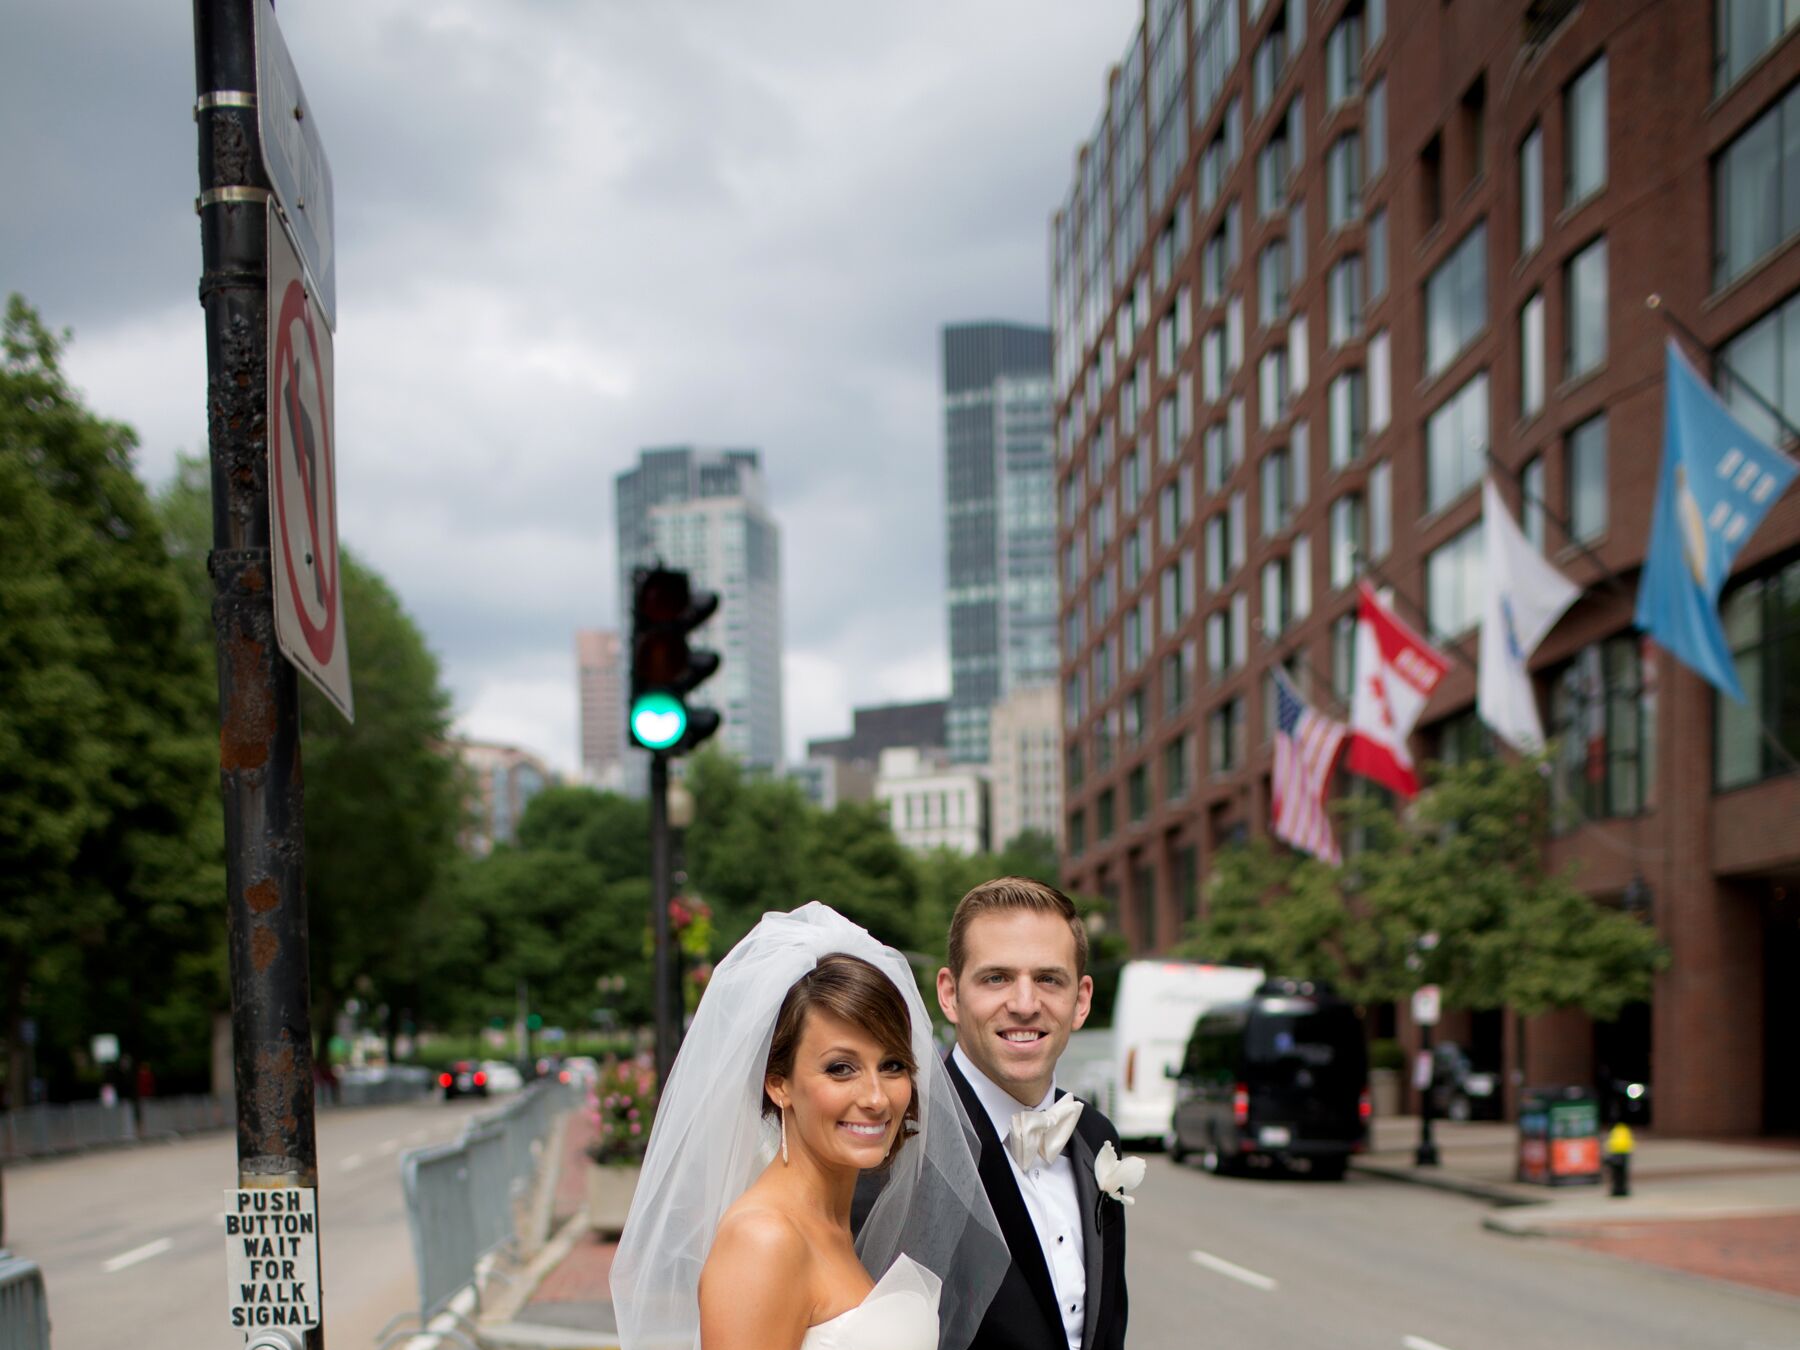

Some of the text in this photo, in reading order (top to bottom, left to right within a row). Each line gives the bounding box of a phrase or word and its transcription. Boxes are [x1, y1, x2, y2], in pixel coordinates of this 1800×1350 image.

[238, 1191, 300, 1213] PUSH
[226, 1213, 313, 1235] BUTTON
[243, 1236, 301, 1257] WAIT
[250, 1260, 295, 1280] FOR
[240, 1282, 305, 1303] WALK
[232, 1305, 317, 1327] SIGNAL
